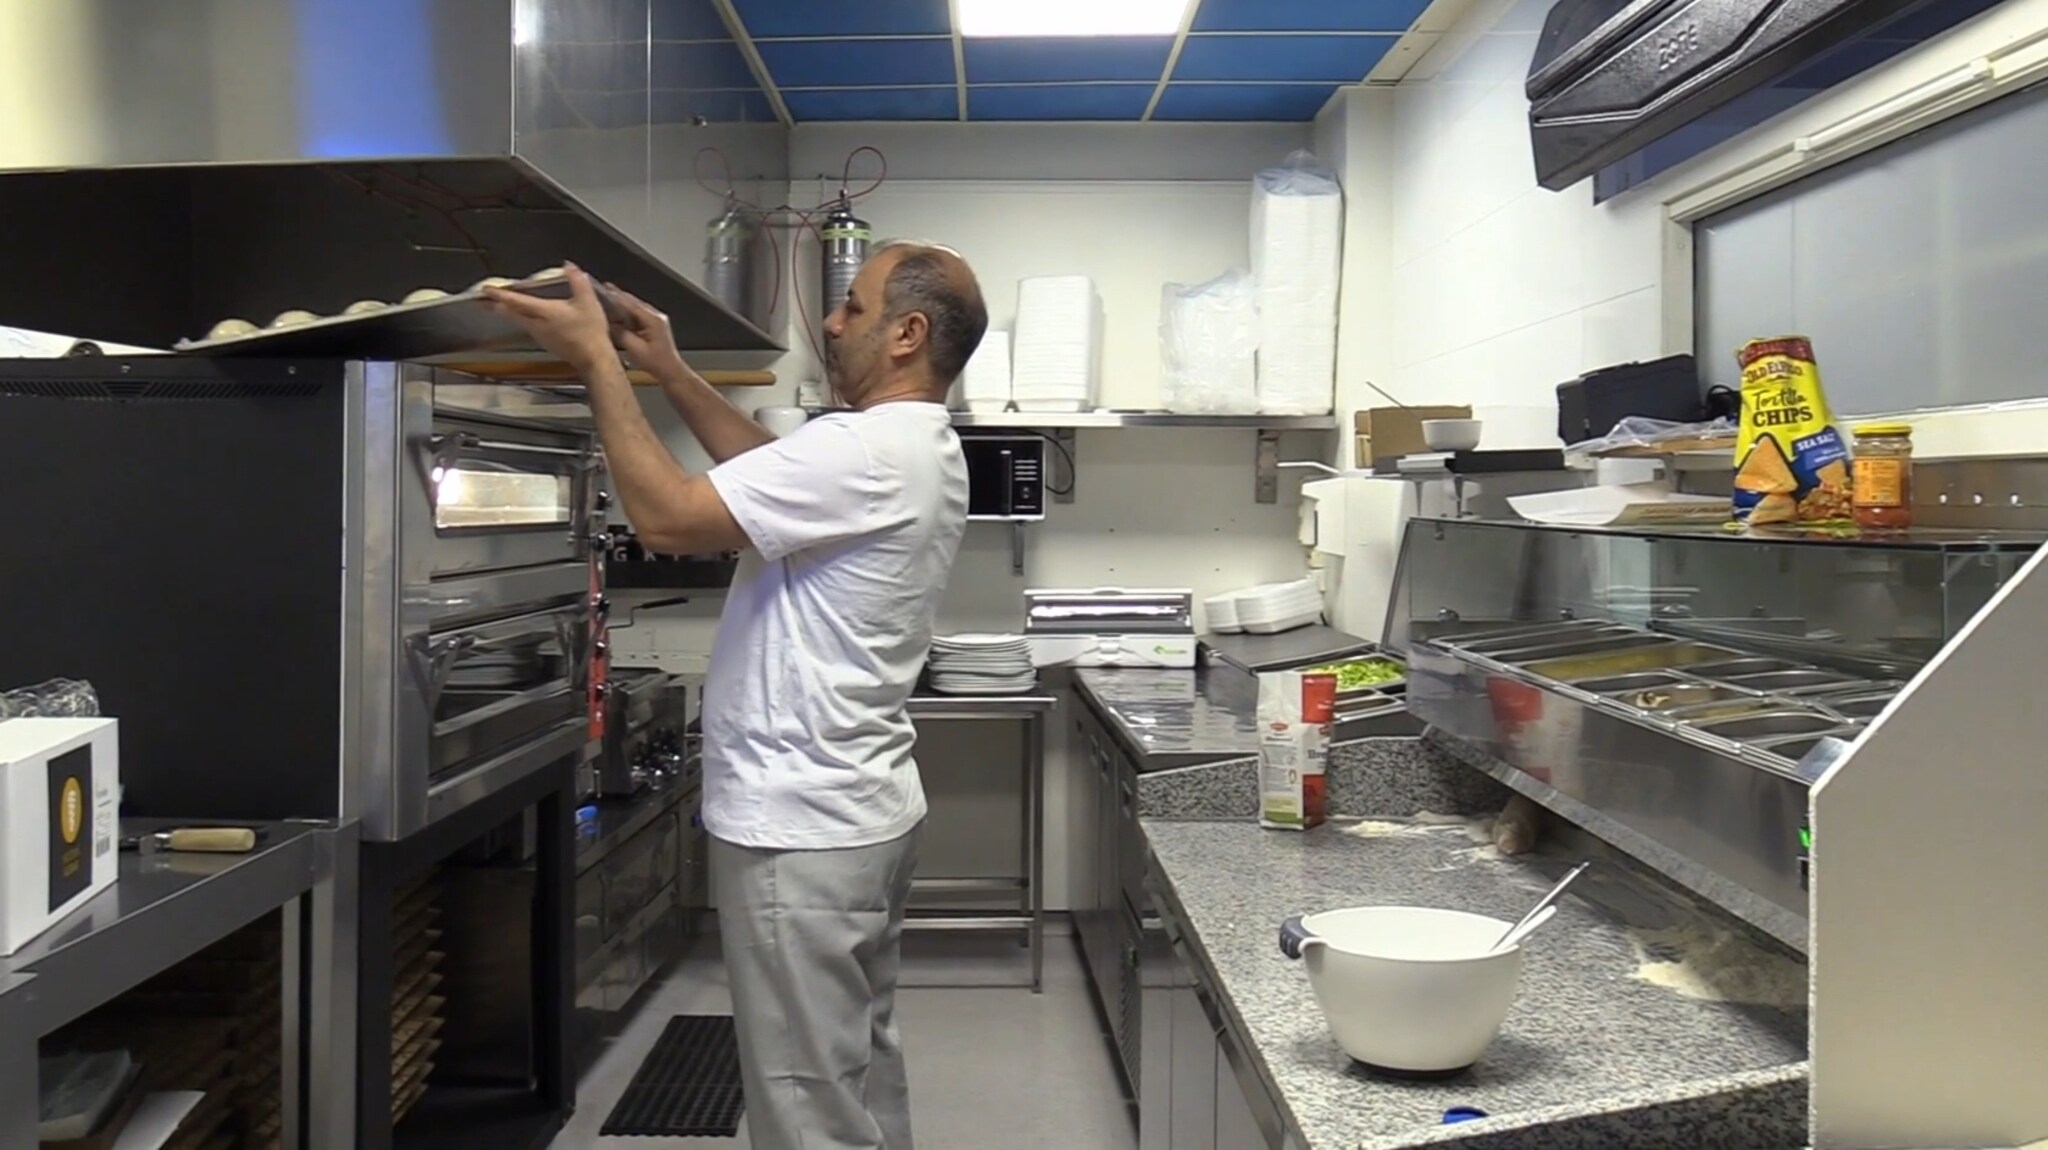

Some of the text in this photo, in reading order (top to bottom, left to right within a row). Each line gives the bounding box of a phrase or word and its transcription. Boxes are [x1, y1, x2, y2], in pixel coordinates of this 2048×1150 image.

[1751, 387, 1807, 411] Tortilla
[1752, 405, 1814, 427] CHIPS
[1796, 438, 1817, 451] SEA
